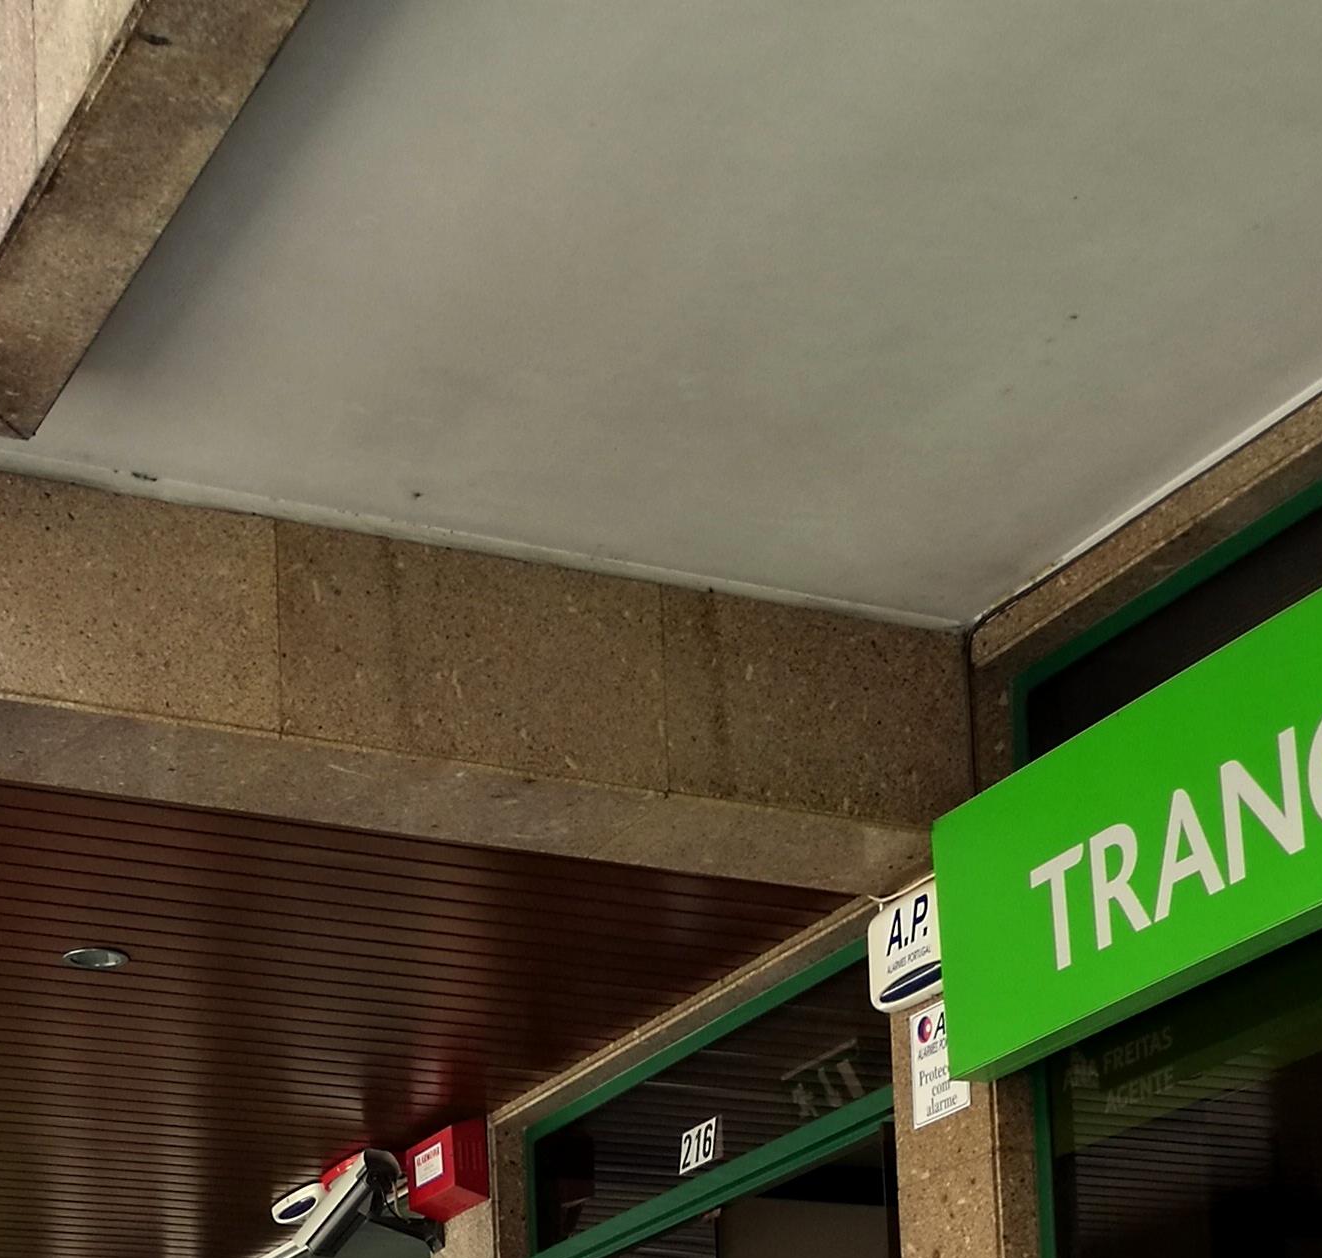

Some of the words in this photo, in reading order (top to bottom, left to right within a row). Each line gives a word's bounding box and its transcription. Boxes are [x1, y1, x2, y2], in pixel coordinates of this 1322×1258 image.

[886, 893, 928, 957] A.P.
[1103, 1025, 1173, 1074] FREITAS
[926, 1093, 957, 1117] alarme
[1104, 1066, 1174, 1114] AGENTE
[682, 1123, 712, 1170] 216
